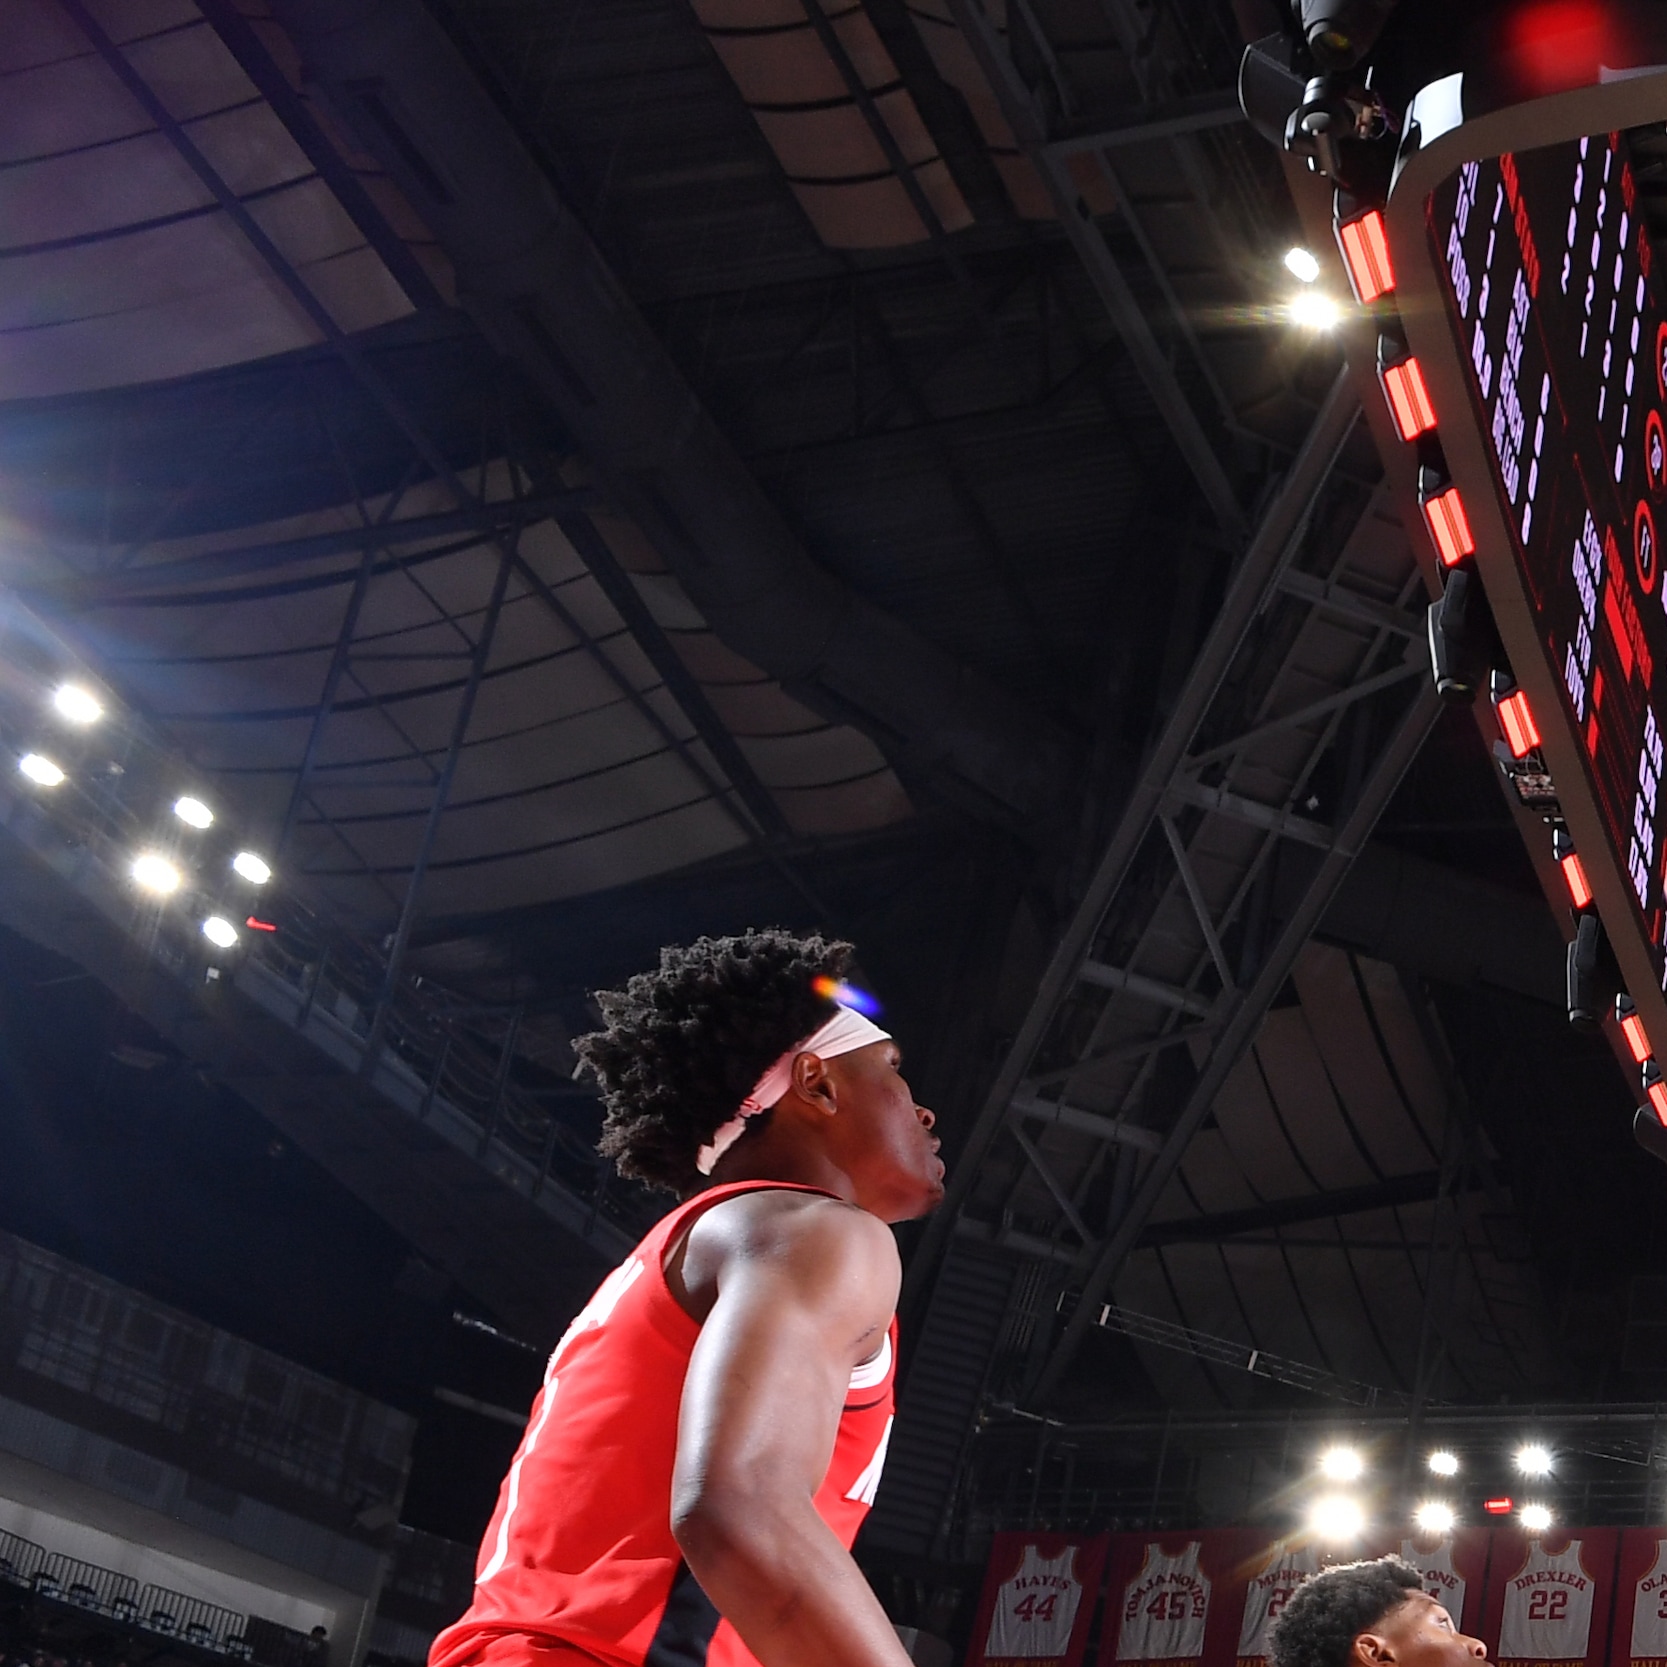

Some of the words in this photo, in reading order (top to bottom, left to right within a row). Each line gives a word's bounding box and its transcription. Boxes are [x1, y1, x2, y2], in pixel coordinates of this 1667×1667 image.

[1013, 1574, 1073, 1593] HAYES
[1514, 1570, 1588, 1593] DREXLER
[1013, 1593, 1058, 1623] 44
[1125, 1572, 1207, 1622] TOMJANOVICH
[1146, 1591, 1187, 1622] 45
[1528, 1590, 1569, 1621] 22
